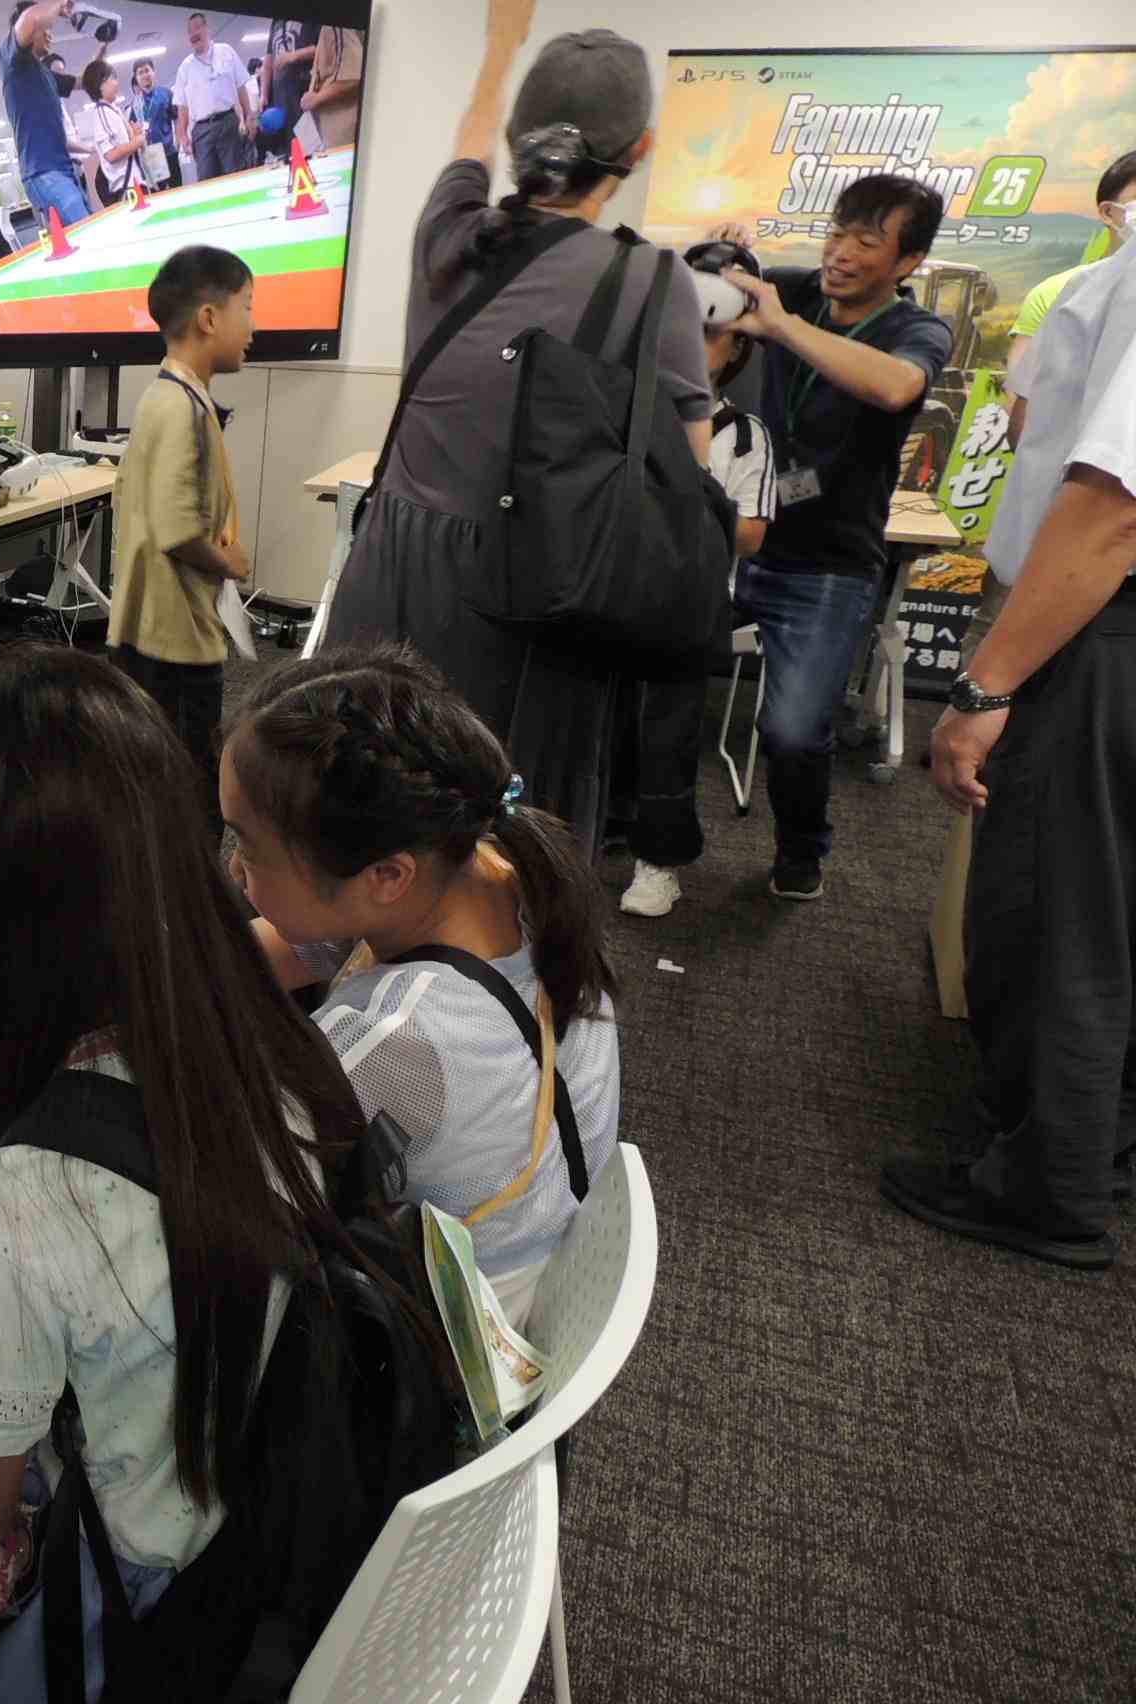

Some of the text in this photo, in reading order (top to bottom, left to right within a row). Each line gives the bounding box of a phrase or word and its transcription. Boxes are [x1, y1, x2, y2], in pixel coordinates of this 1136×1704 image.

[700, 70, 745, 82] PS5
[778, 71, 813, 81] STEAM
[772, 94, 941, 164] Farming
[292, 167, 320, 208] A
[983, 168, 1030, 206] 25
[1001, 225, 1030, 243] 25
